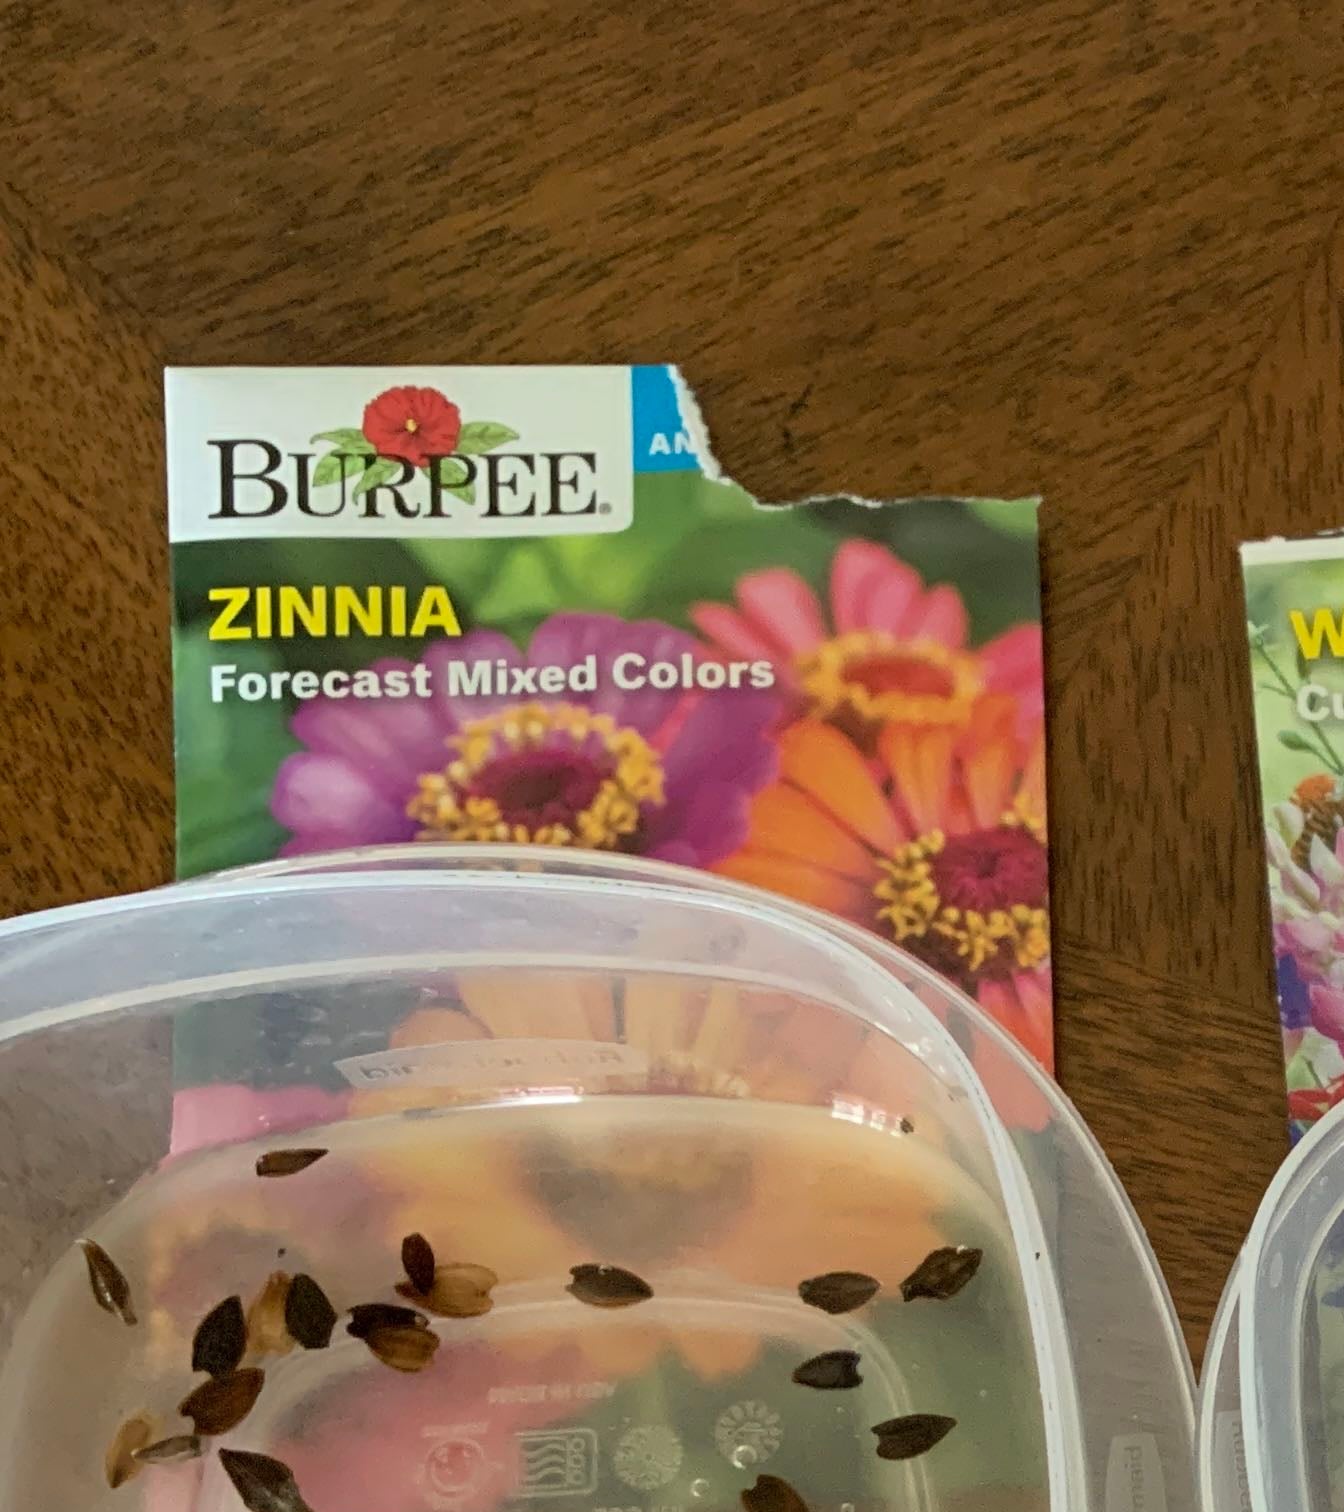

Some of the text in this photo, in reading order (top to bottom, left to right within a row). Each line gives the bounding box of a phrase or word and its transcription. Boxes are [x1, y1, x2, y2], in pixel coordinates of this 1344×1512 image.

[207, 586, 462, 642] ZINNIA
[210, 652, 775, 704] Forecast Mixed Colors
